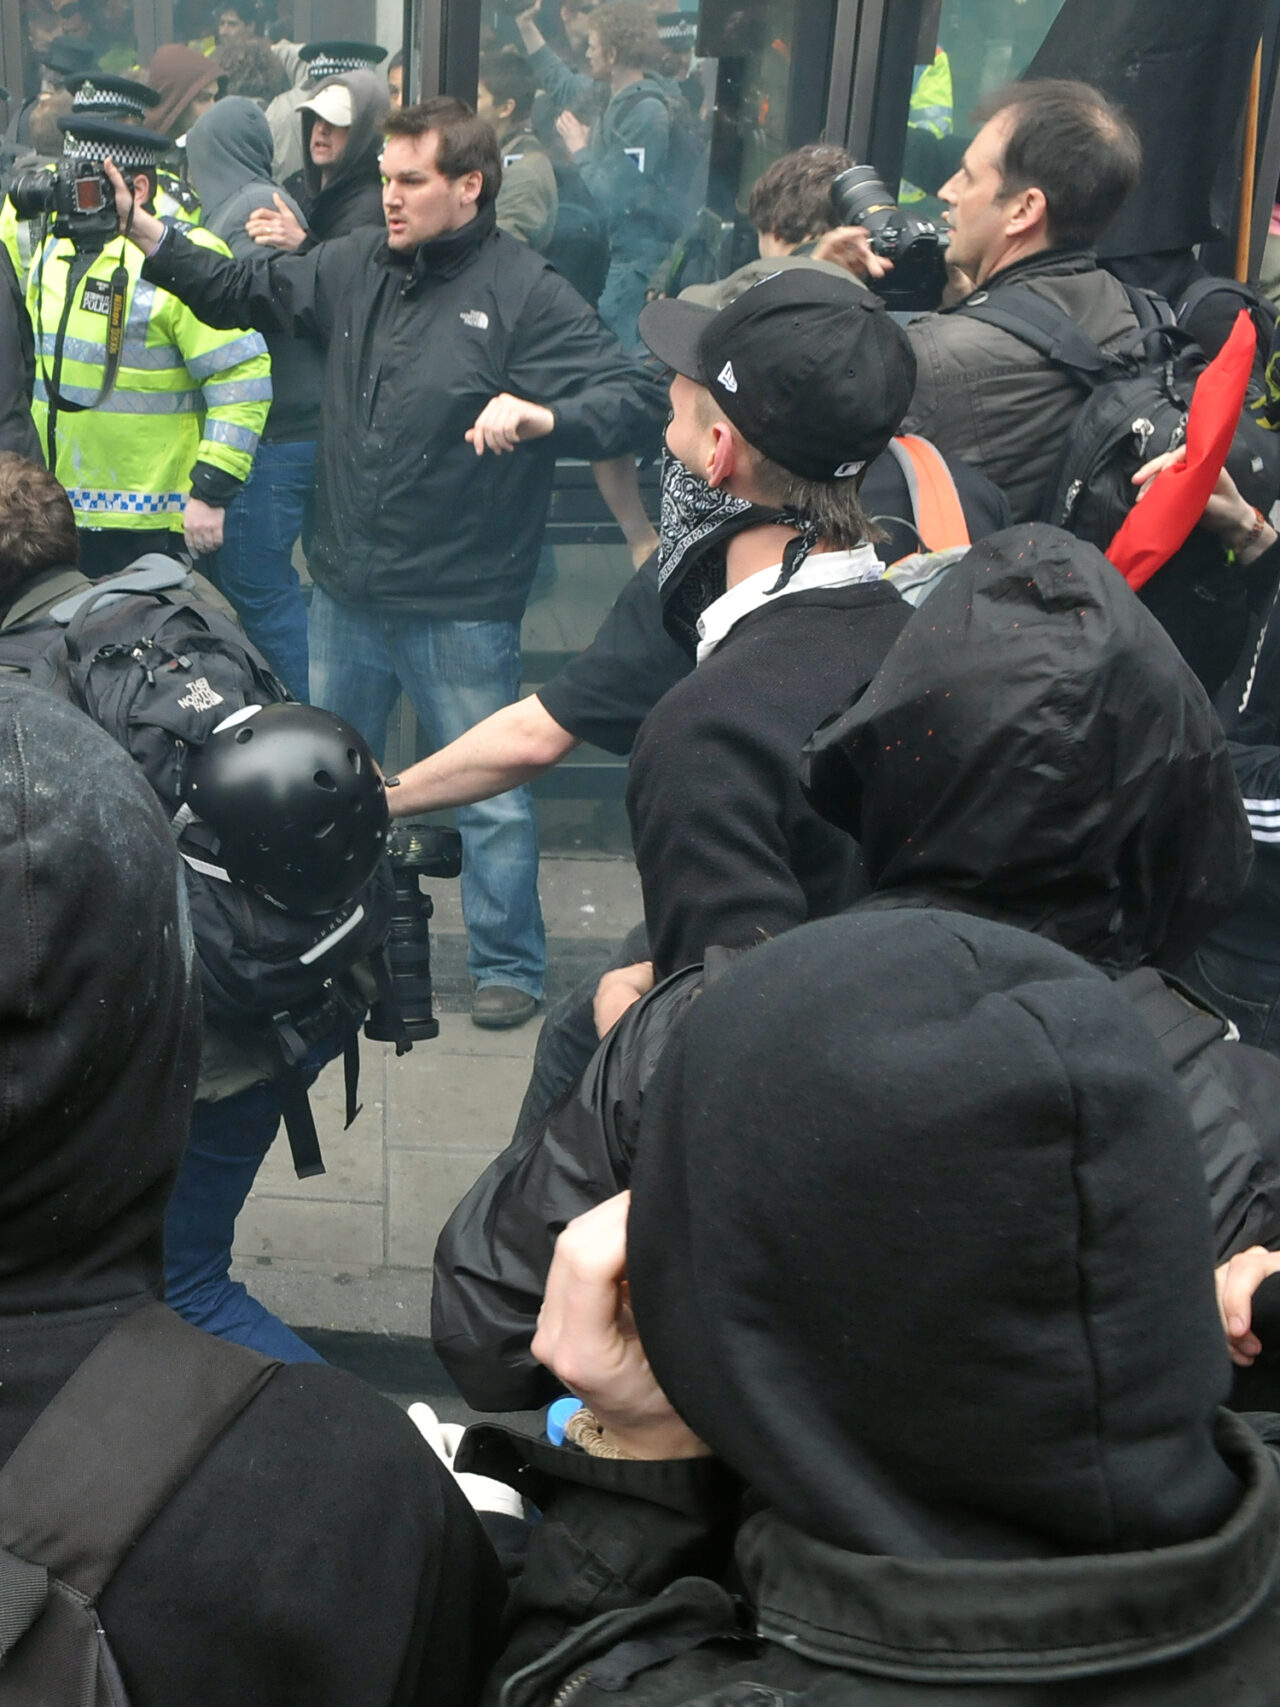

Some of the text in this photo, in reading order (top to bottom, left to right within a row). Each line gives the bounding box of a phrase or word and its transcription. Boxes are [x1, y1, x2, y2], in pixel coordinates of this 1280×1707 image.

[82, 299, 110, 314] POLIC
[185, 677, 209, 694] THE
[177, 686, 212, 709] NORTH
[193, 696, 216, 713] FACE
